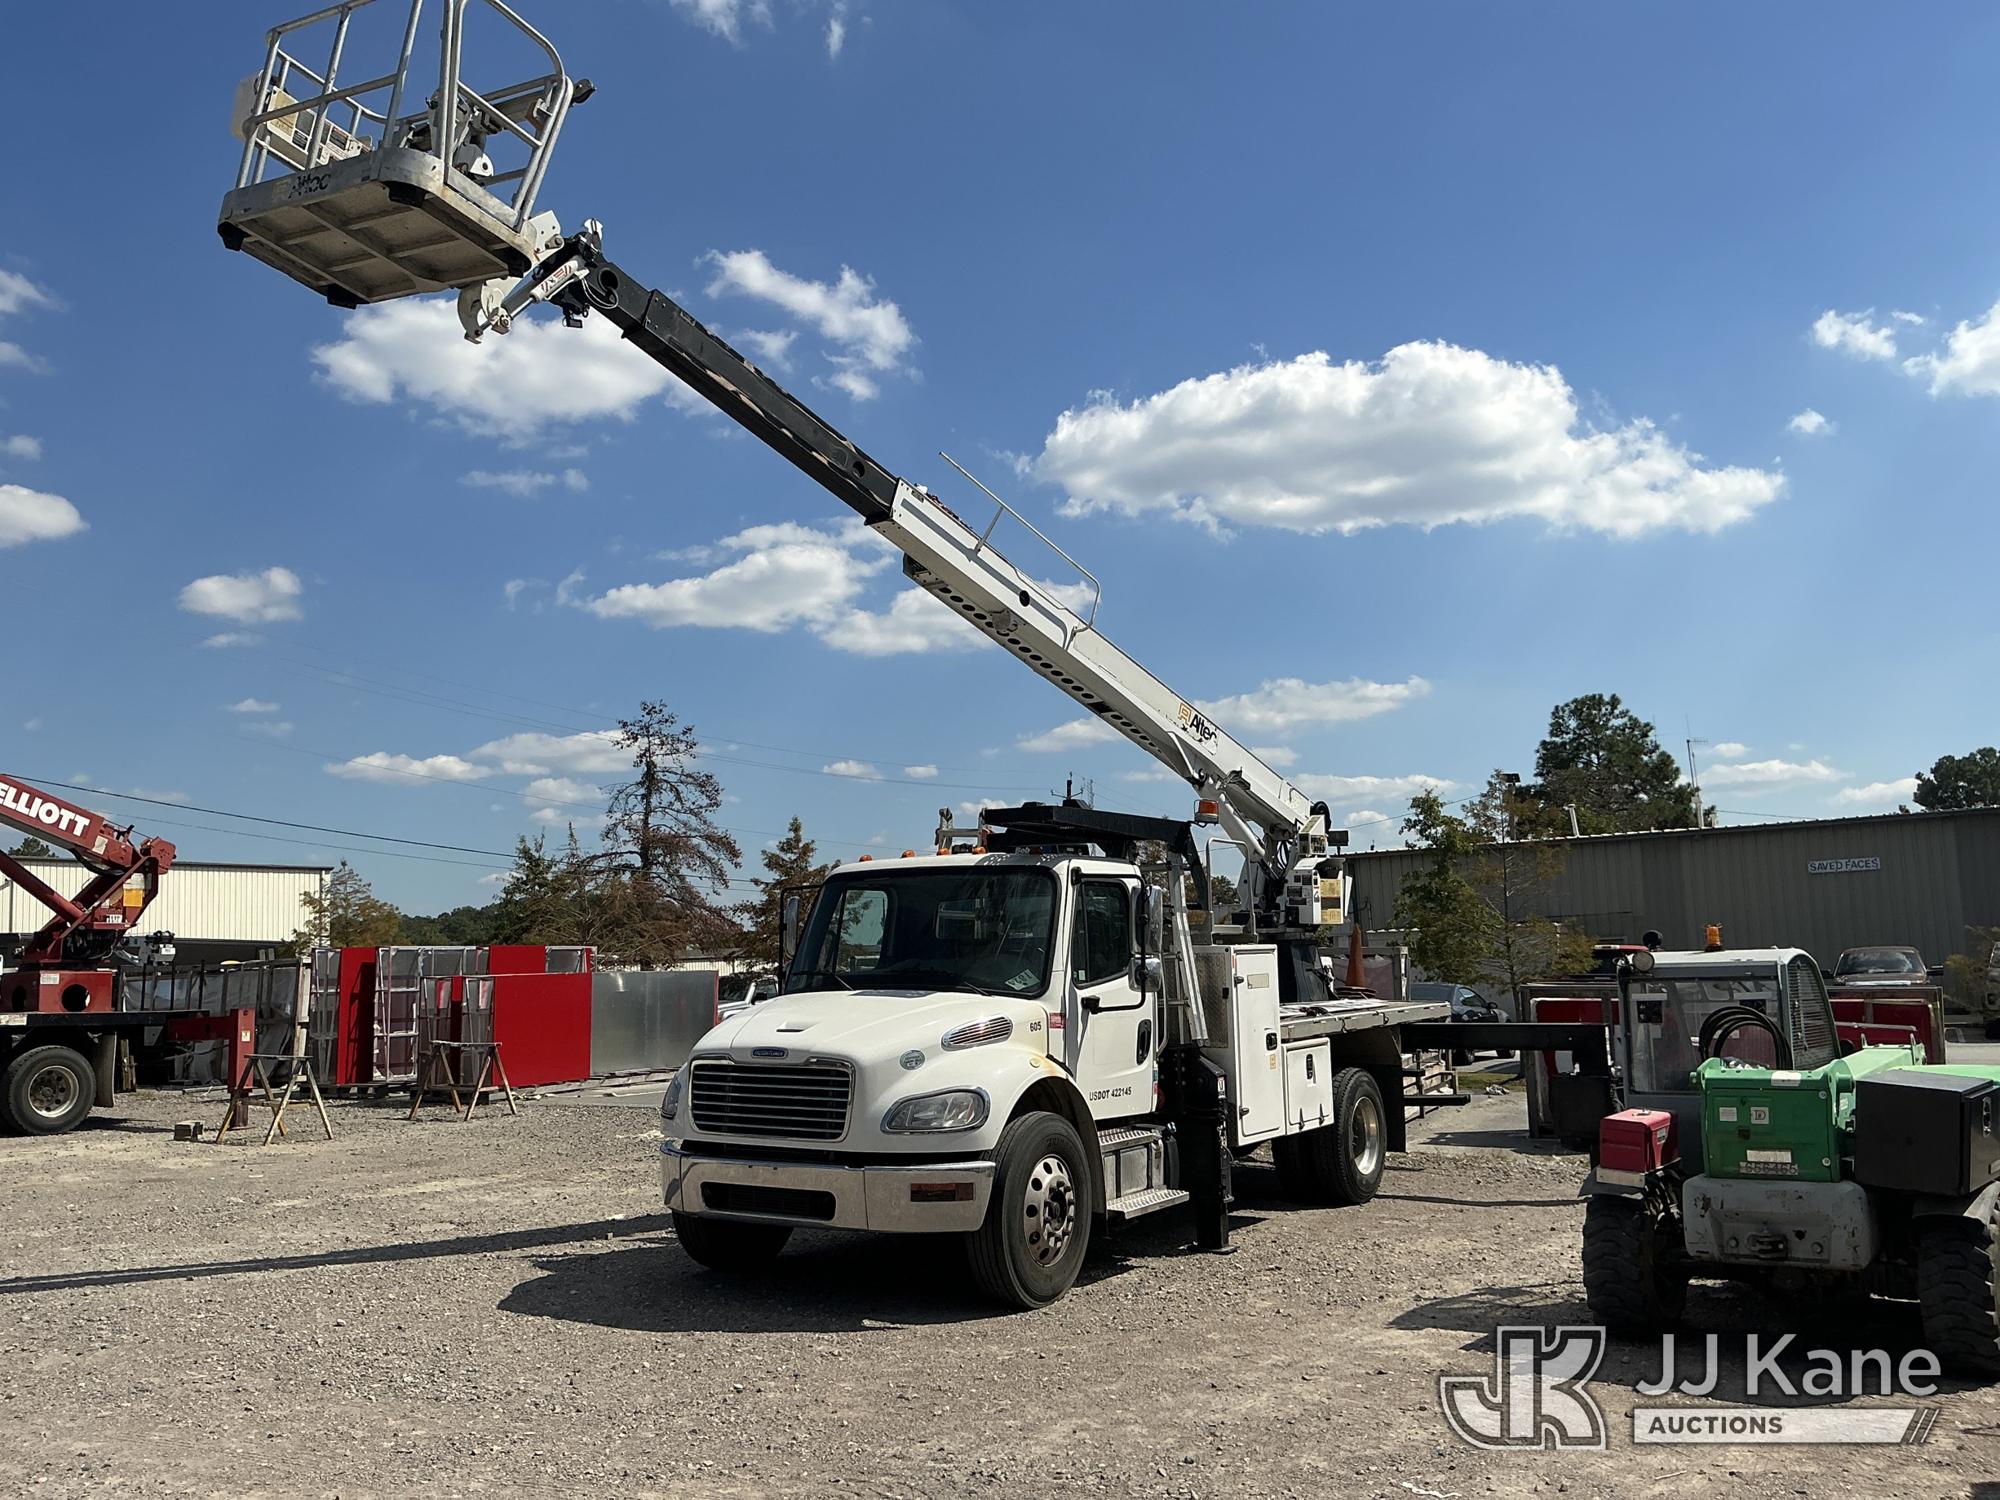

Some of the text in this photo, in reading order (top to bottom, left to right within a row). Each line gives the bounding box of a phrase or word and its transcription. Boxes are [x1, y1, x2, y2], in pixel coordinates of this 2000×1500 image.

[0, 781, 91, 837] ELLIOTT
[1809, 858, 1879, 872] SAVED FACES
[1029, 1020, 1042, 1032] 605
[1089, 1086, 1132, 1101] USDOT 422145
